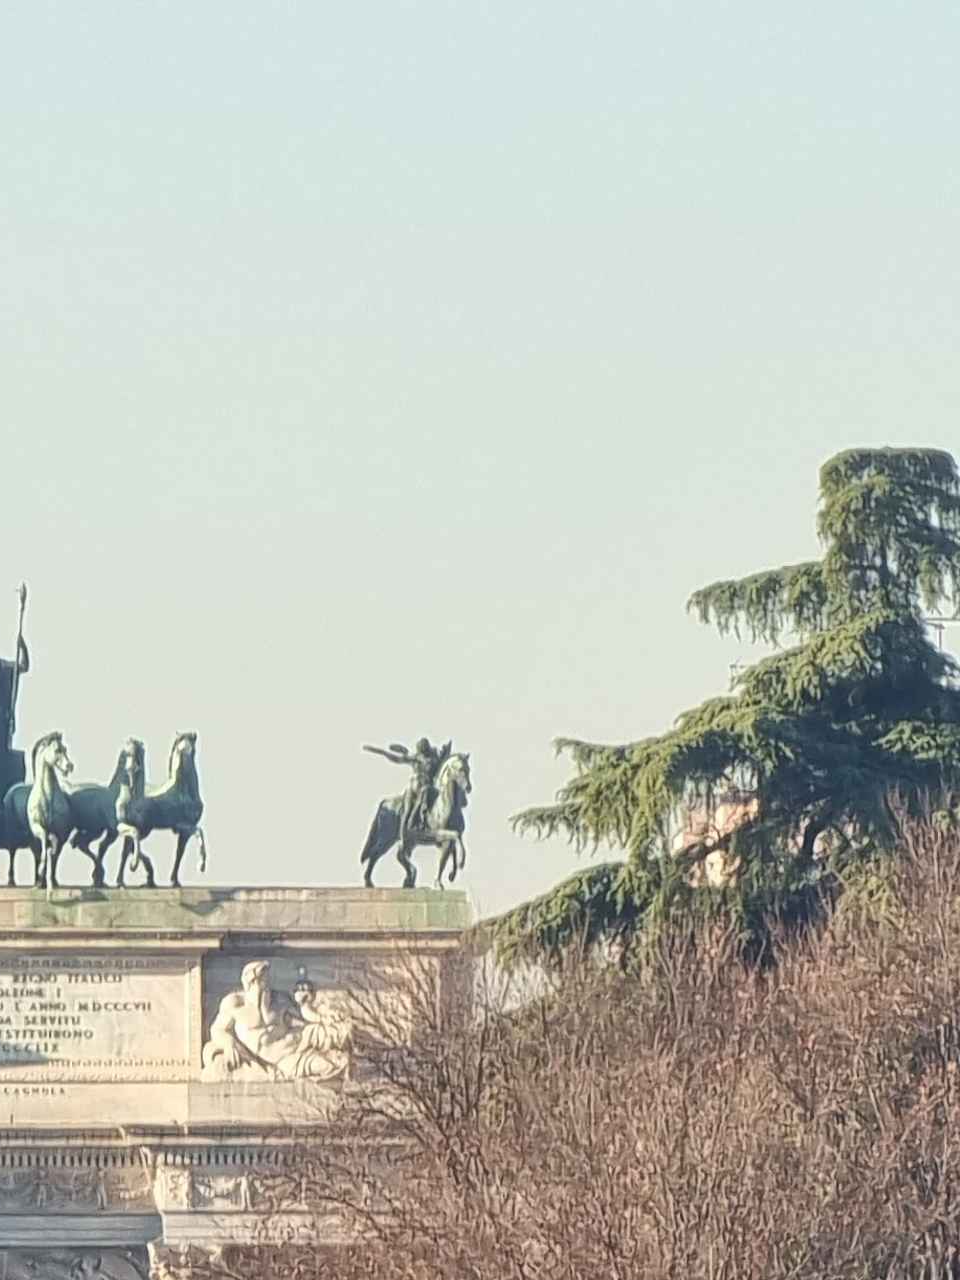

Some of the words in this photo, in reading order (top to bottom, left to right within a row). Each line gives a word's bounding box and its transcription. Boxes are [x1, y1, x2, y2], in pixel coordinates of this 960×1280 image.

[13, 972, 56, 984] REGNO
[68, 972, 122, 984] ITALICO
[56, 986, 61, 999] I
[78, 1000, 151, 1013] MDCCCVII
[3, 1086, 65, 1097] CAGNOLA
